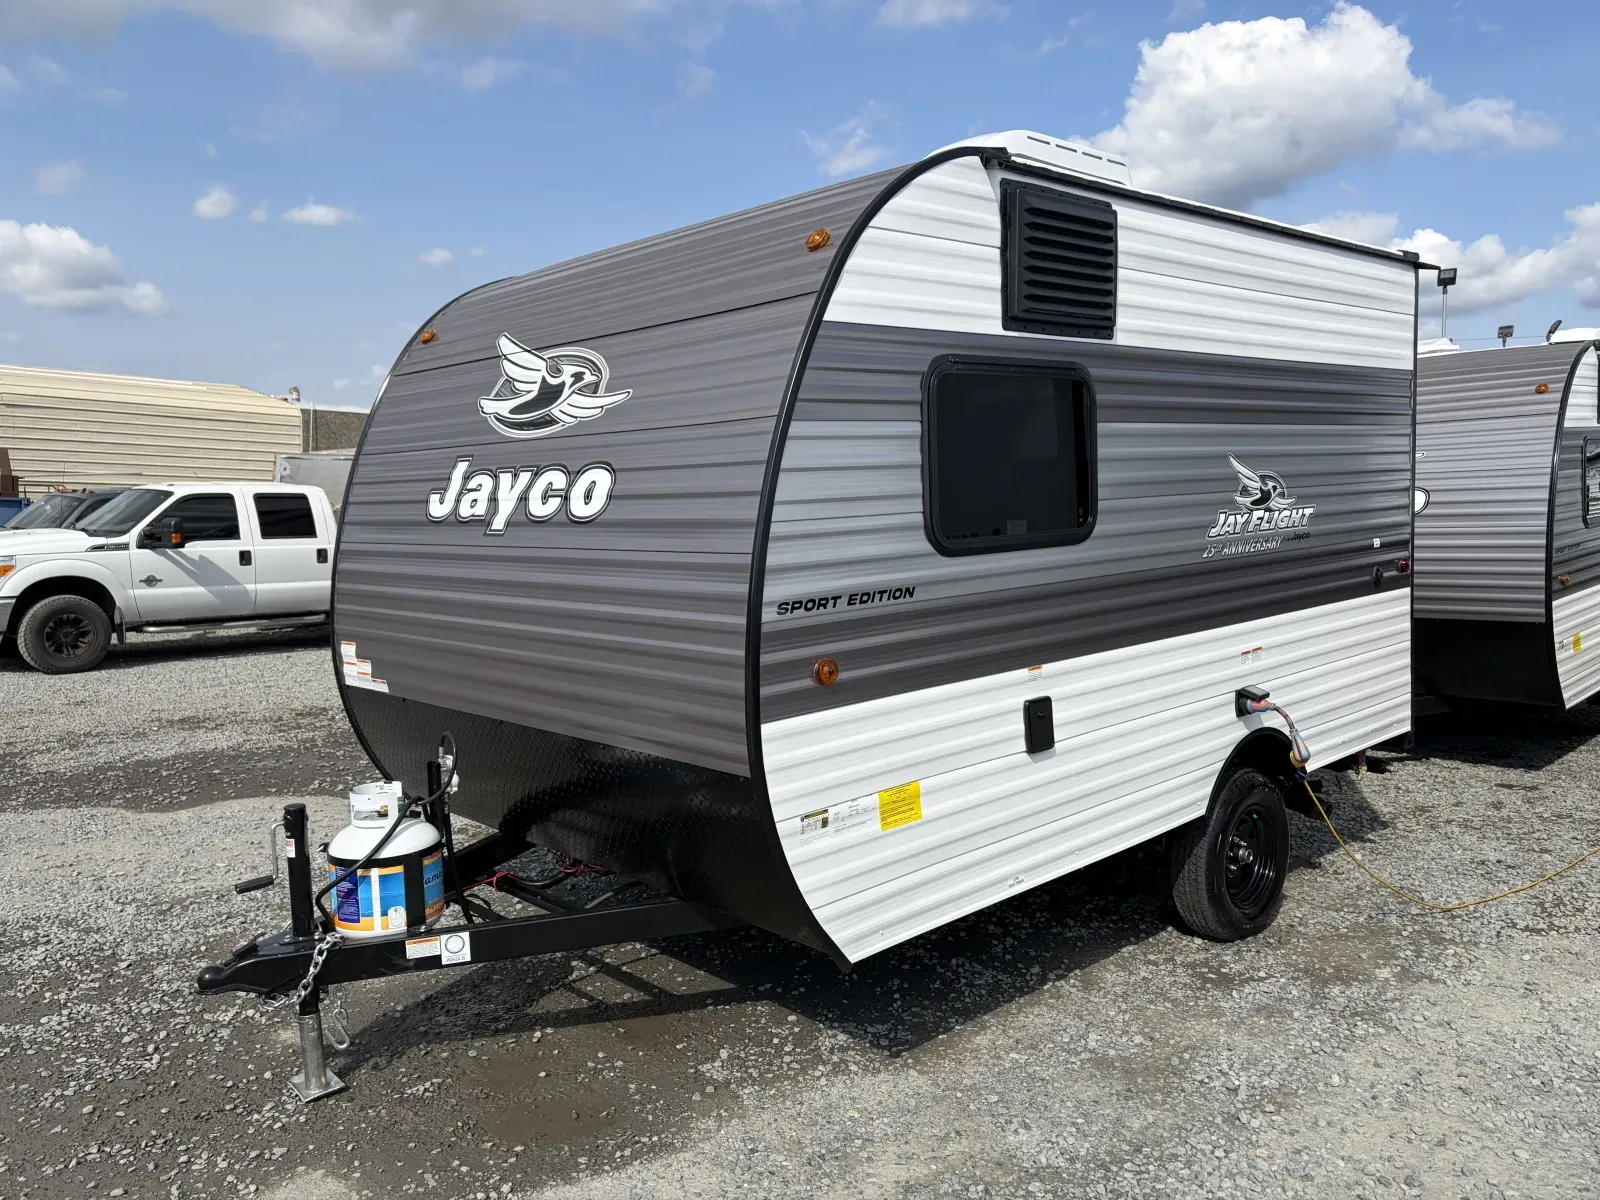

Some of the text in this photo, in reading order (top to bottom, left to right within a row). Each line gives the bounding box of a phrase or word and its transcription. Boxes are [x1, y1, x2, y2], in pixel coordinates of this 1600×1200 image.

[427, 457, 615, 533] Jayco
[1207, 506, 1315, 538] JAY FLIGHT
[1222, 535, 1283, 556] ANNIVERSARY
[776, 586, 916, 616] SPORT EDITION
